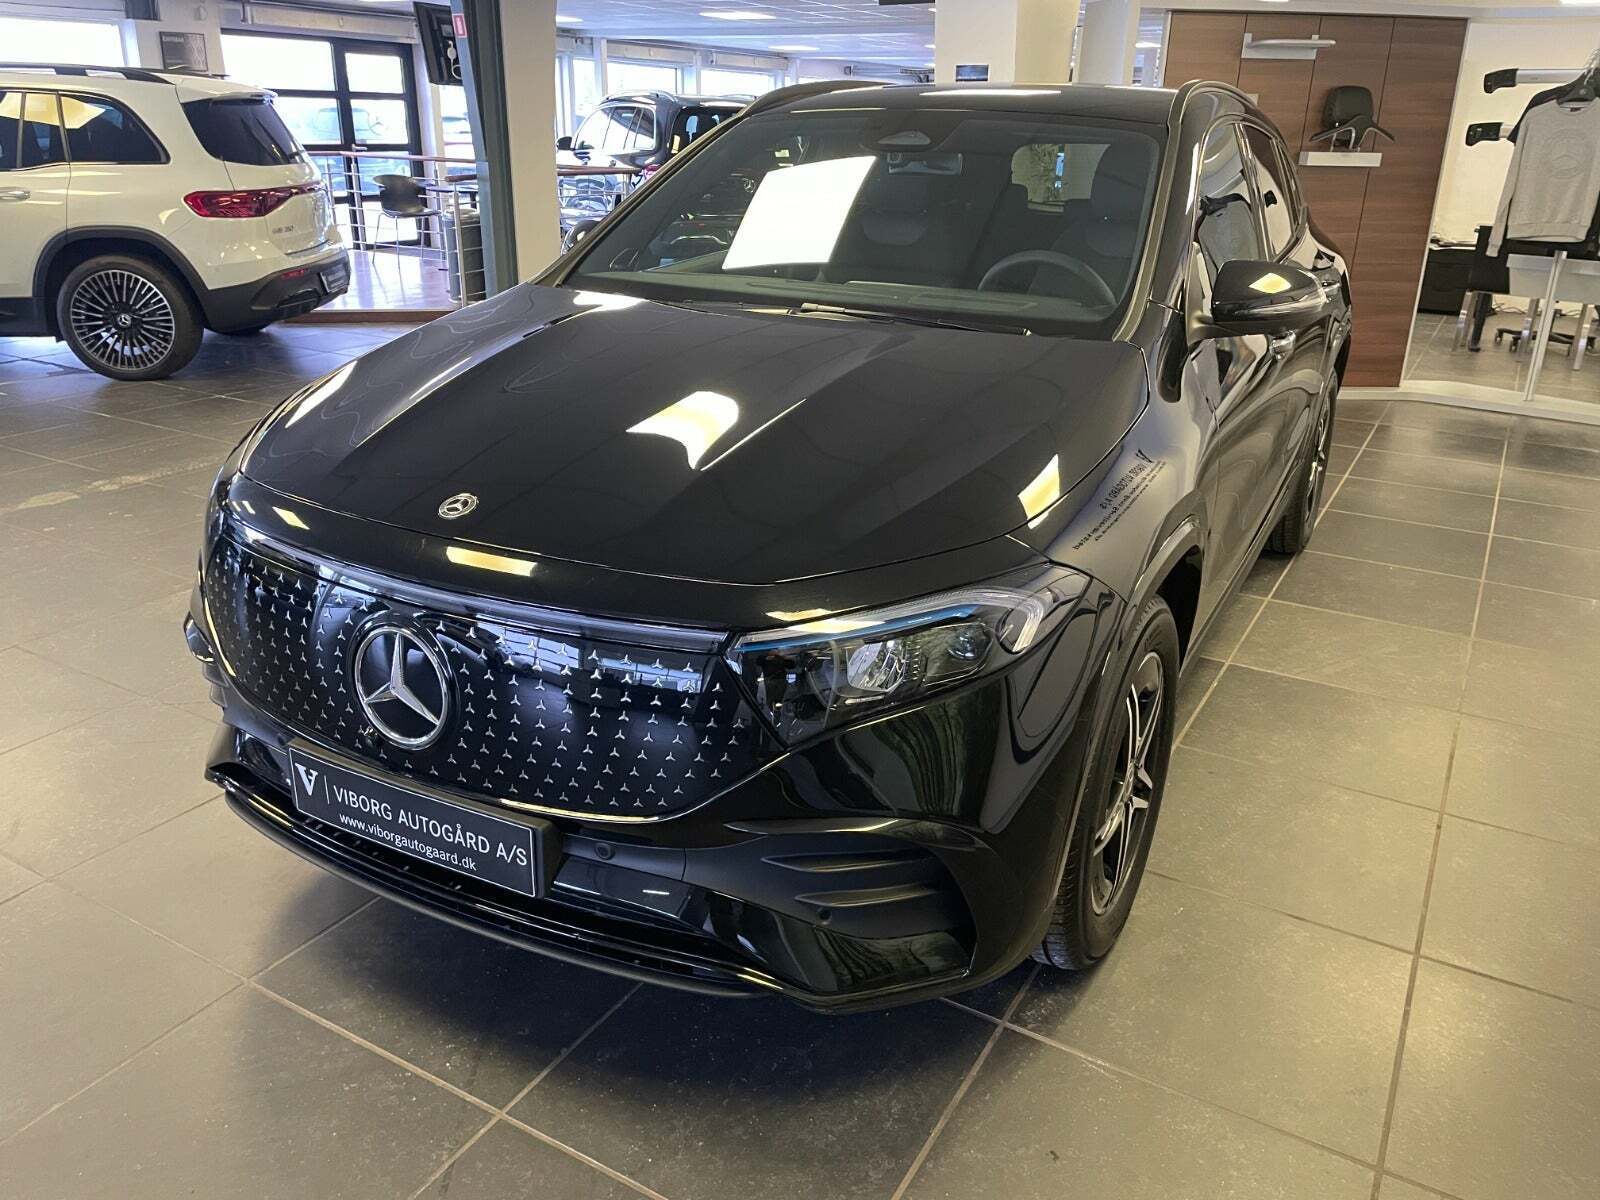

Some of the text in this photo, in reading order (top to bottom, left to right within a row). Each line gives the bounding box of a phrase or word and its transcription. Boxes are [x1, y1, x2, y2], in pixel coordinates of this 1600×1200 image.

[334, 785, 528, 866] VIBORG AUTOGÅRD A/S
[340, 814, 476, 870] www.viborgautogaard.dk
